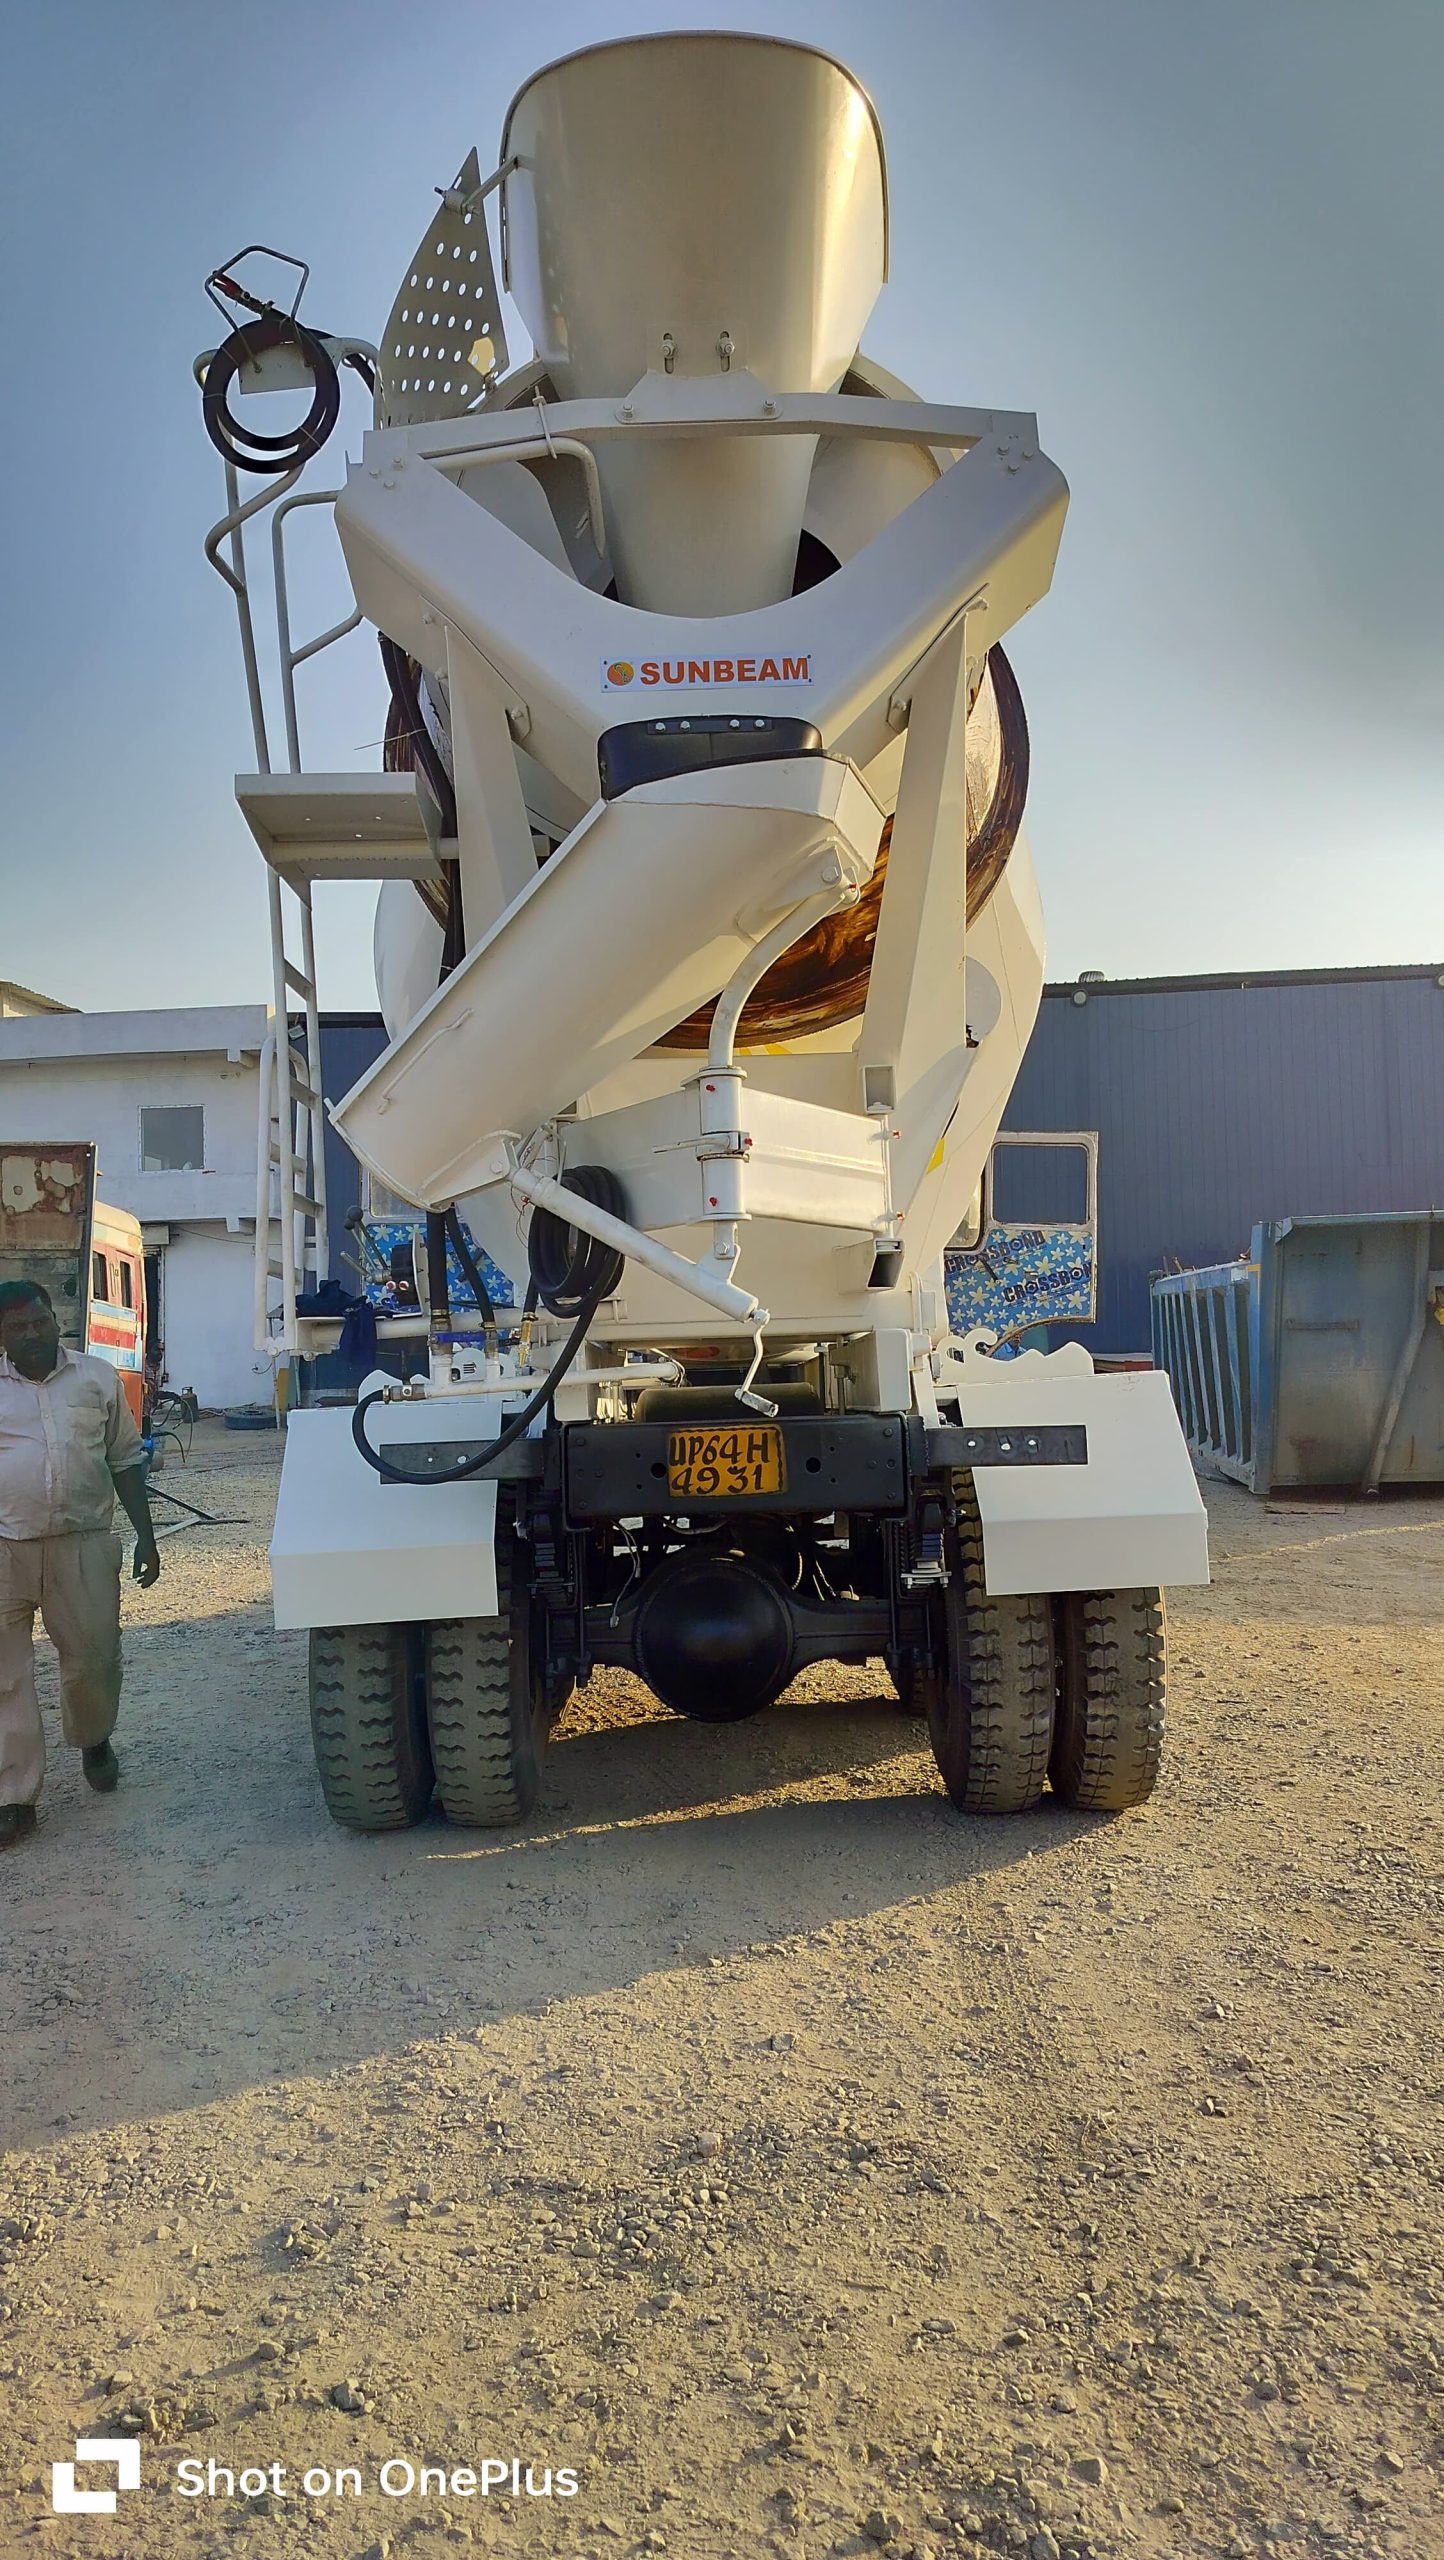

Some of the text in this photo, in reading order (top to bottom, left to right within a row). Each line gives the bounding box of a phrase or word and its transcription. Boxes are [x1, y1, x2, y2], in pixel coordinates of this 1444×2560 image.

[640, 657, 809, 685] SUNBEAM
[1003, 1262, 1091, 1303] CROSSBON
[671, 1464, 763, 1495] 4931
